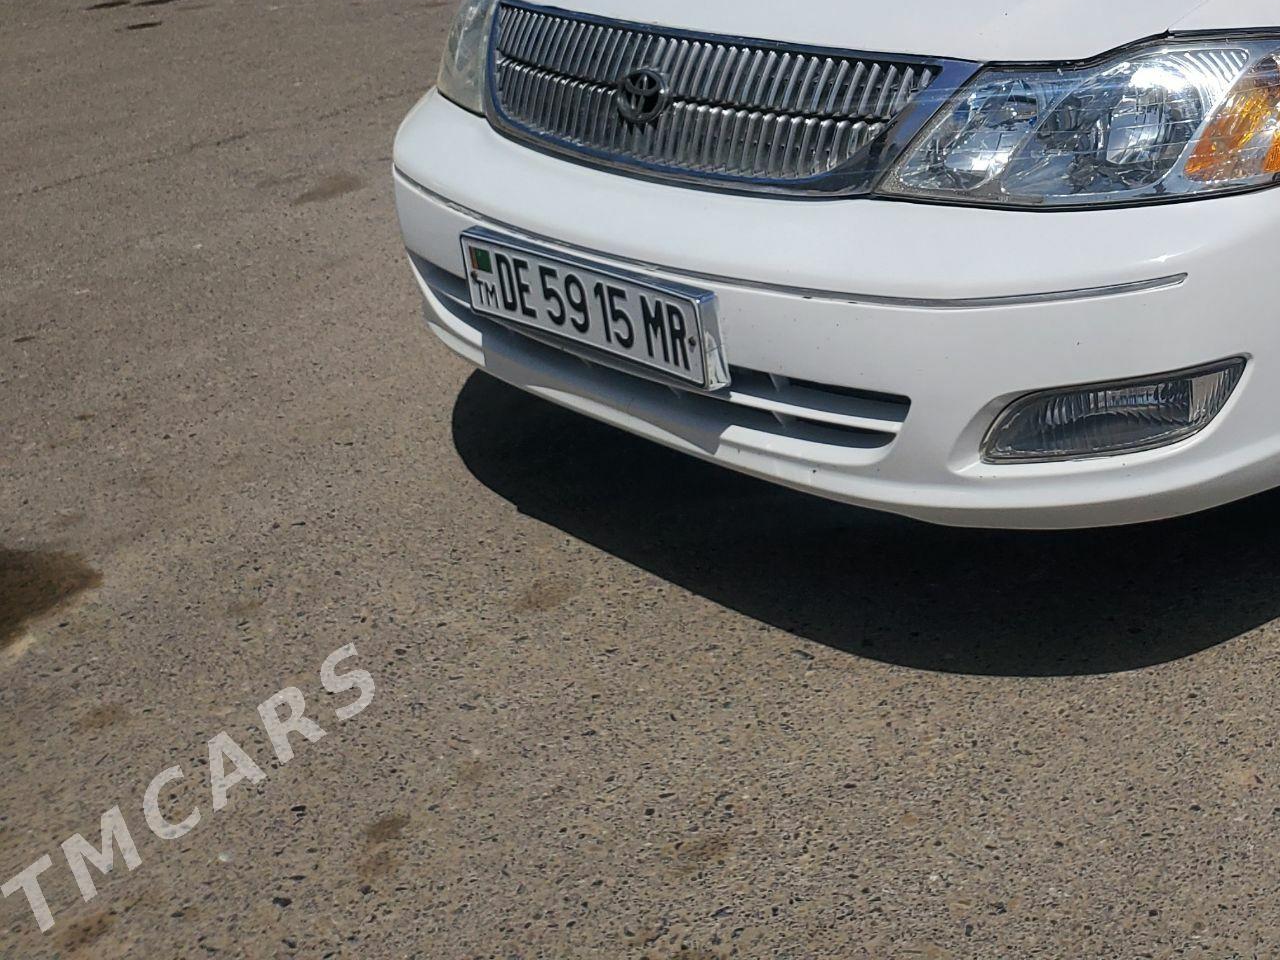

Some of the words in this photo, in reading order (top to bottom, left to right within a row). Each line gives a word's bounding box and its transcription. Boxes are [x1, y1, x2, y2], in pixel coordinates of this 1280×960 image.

[474, 279, 499, 309] TM
[494, 252, 537, 319] DE
[538, 264, 635, 349] 5915
[640, 294, 690, 371] MR
